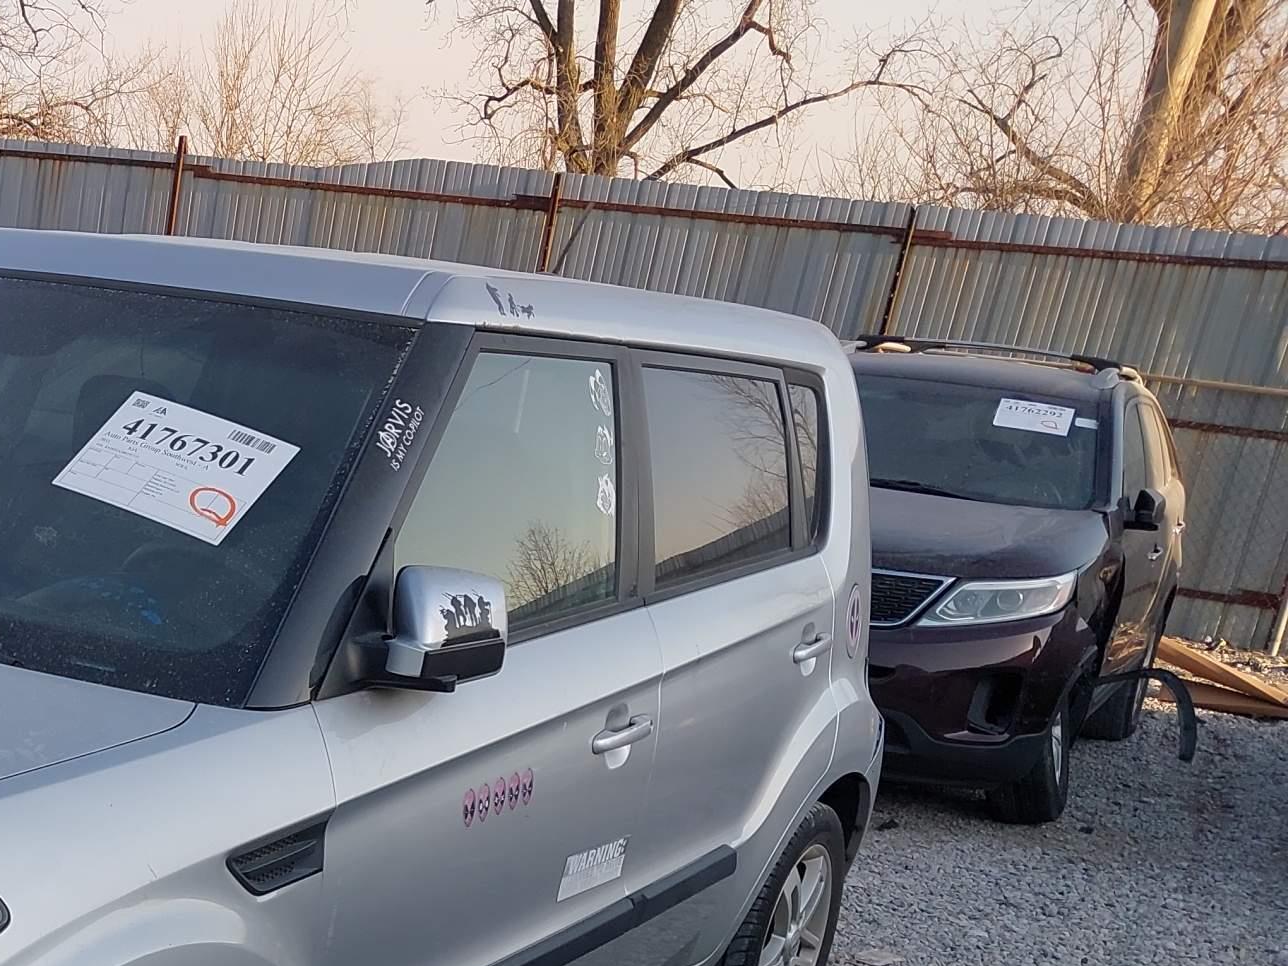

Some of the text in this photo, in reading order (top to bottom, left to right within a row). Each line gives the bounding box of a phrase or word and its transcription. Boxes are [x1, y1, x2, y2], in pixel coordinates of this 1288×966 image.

[376, 399, 412, 458] JARVIS
[122, 418, 256, 477] 41767301
[122, 435, 139, 446] Parts
[139, 441, 162, 454] Group
[162, 449, 197, 467] Southwest
[395, 444, 407, 462] MY
[390, 459, 401, 472] IS
